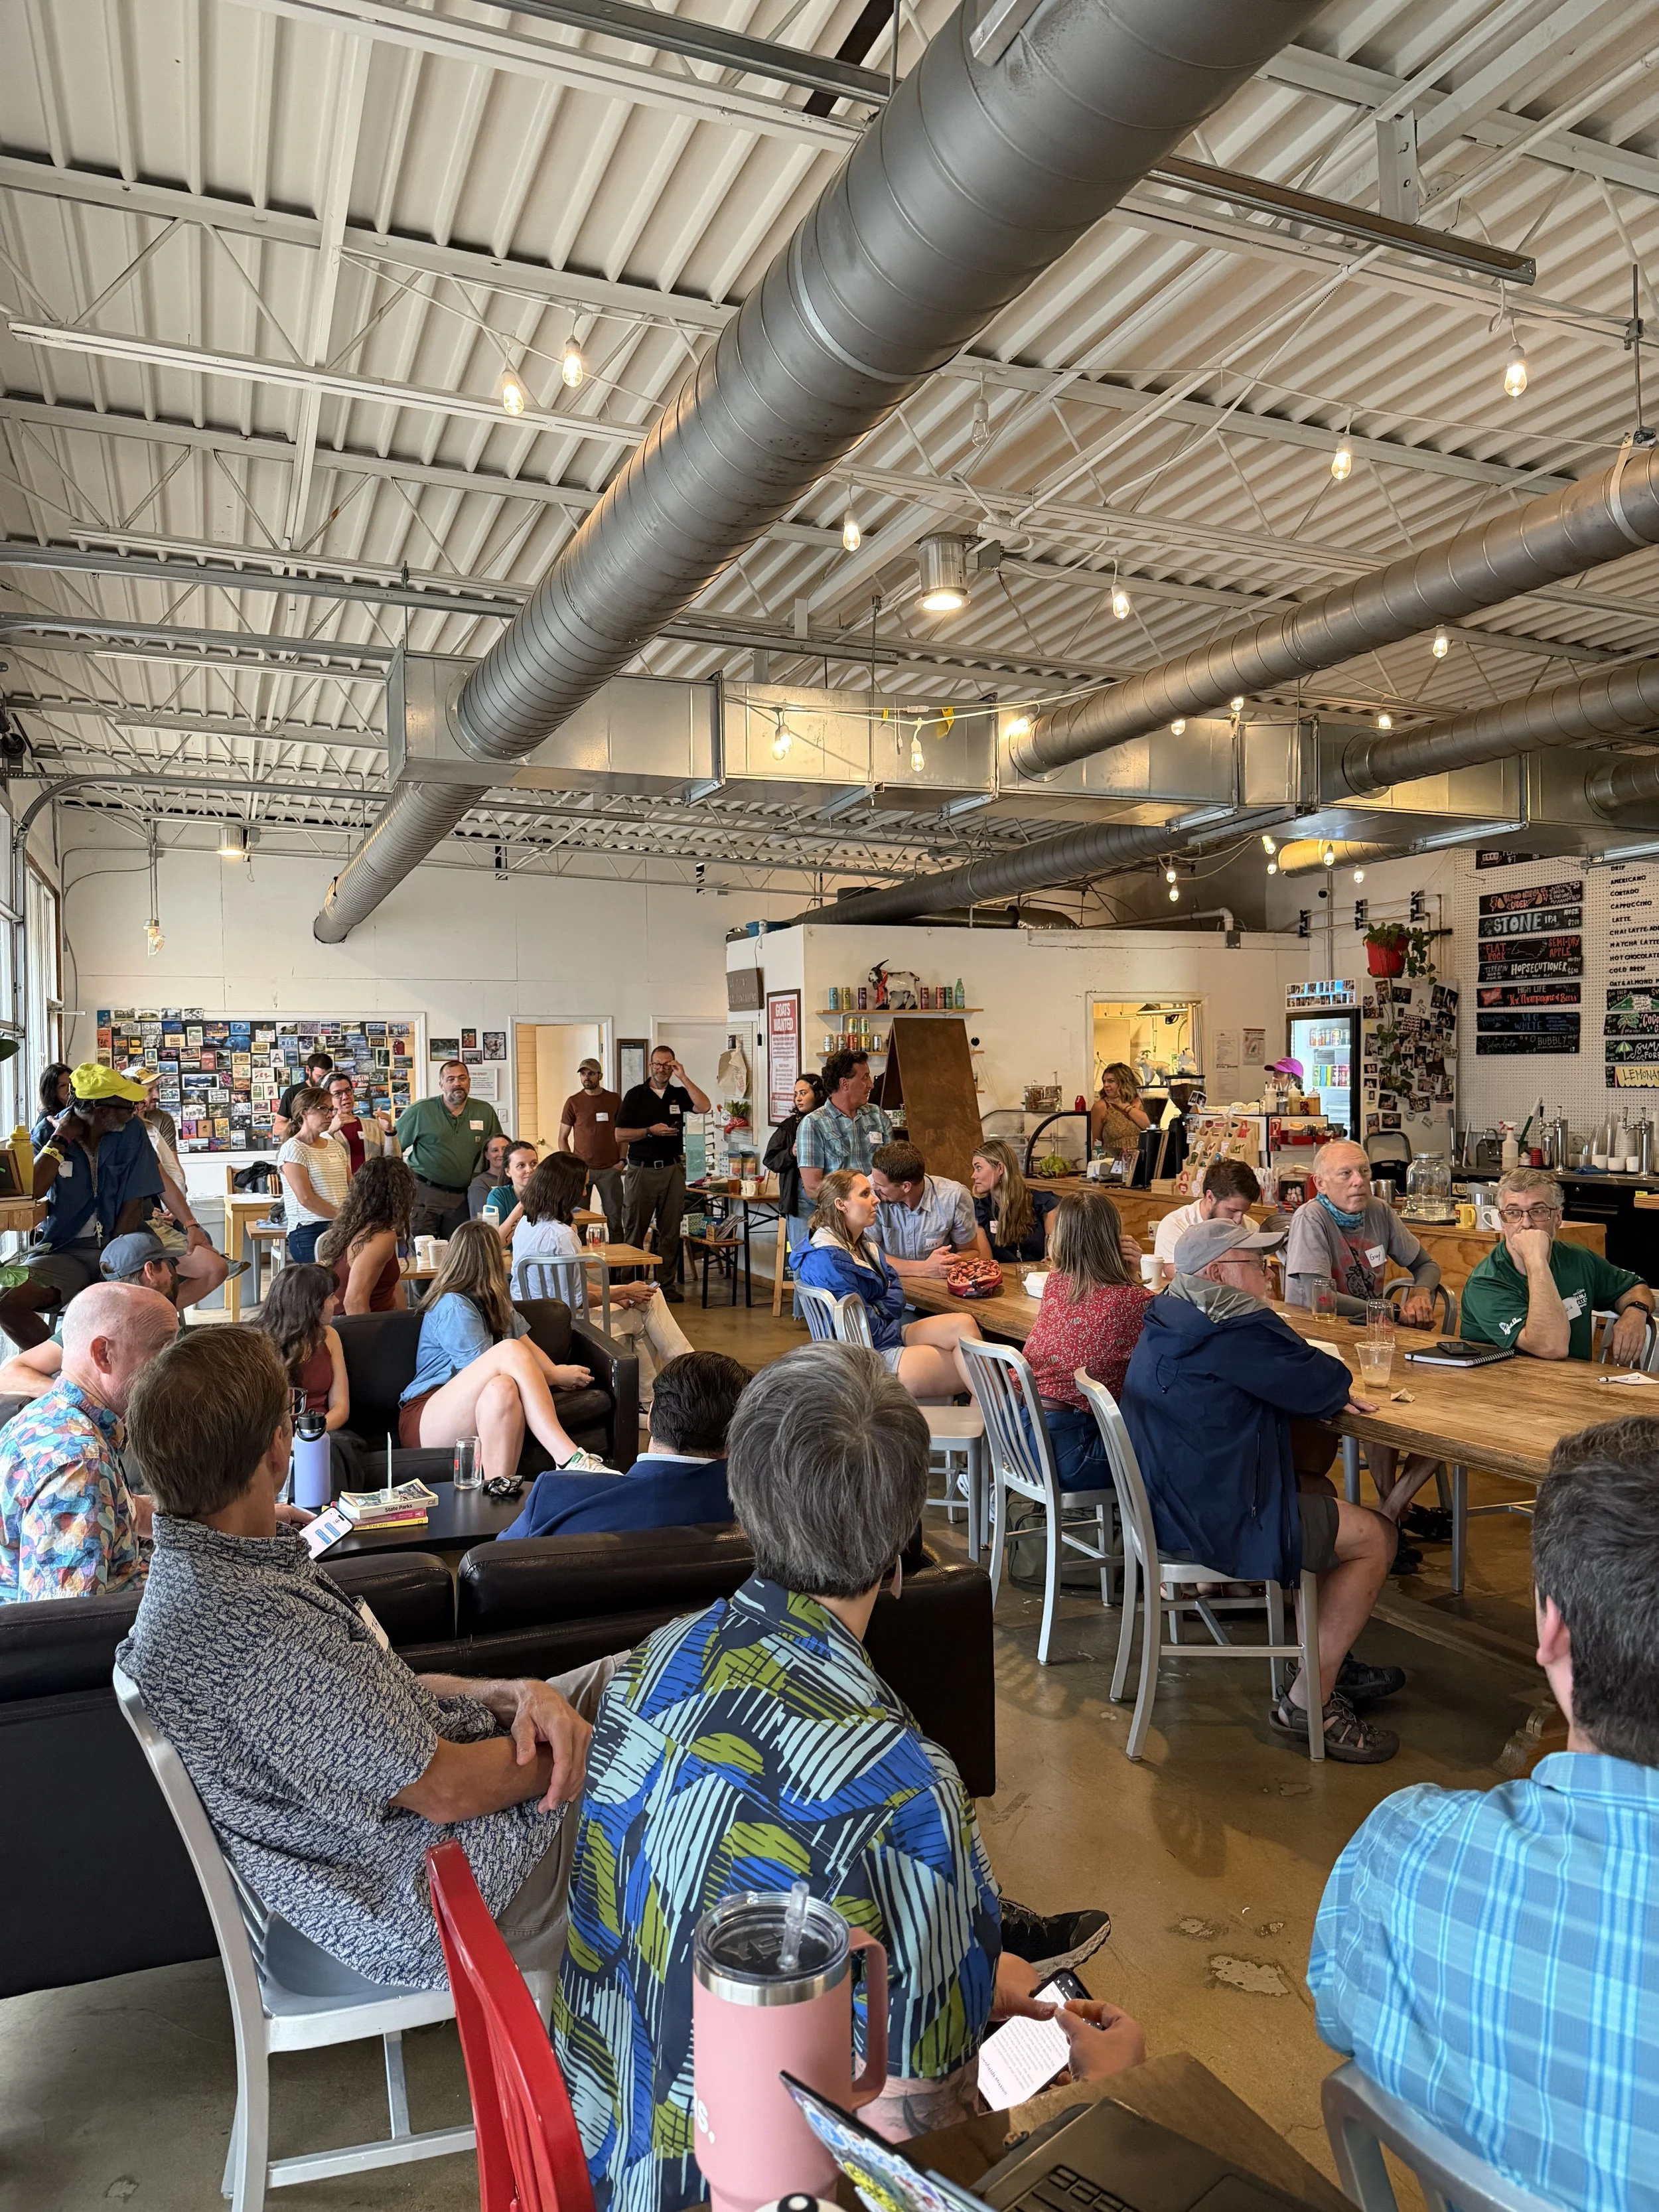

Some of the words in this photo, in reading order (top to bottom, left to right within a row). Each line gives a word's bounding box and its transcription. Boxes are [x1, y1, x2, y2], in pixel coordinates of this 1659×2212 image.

[1611, 875, 1646, 885] AMERICANO
[1610, 888, 1639, 897] CORTADO
[1610, 900, 1652, 909] CAPPUCCINO
[1494, 912, 1543, 934] STONE
[1544, 915, 1557, 924] IPA
[1486, 942, 1506, 954] FLAT
[1548, 936, 1580, 948] SEMI-DRY
[1610, 940, 1638, 948] MATCHA
[1487, 952, 1506, 962] ROCK
[1549, 946, 1572, 958] APPLE
[1517, 986, 1531, 994] HIGH
[775, 1002, 790, 1017] GOATS
[773, 1017, 794, 1031] WANTED
[1514, 1021, 1543, 1031] WHITE
[1538, 1034, 1567, 1047] BUBBLY
[1369, 1250, 1381, 1262] Guy
